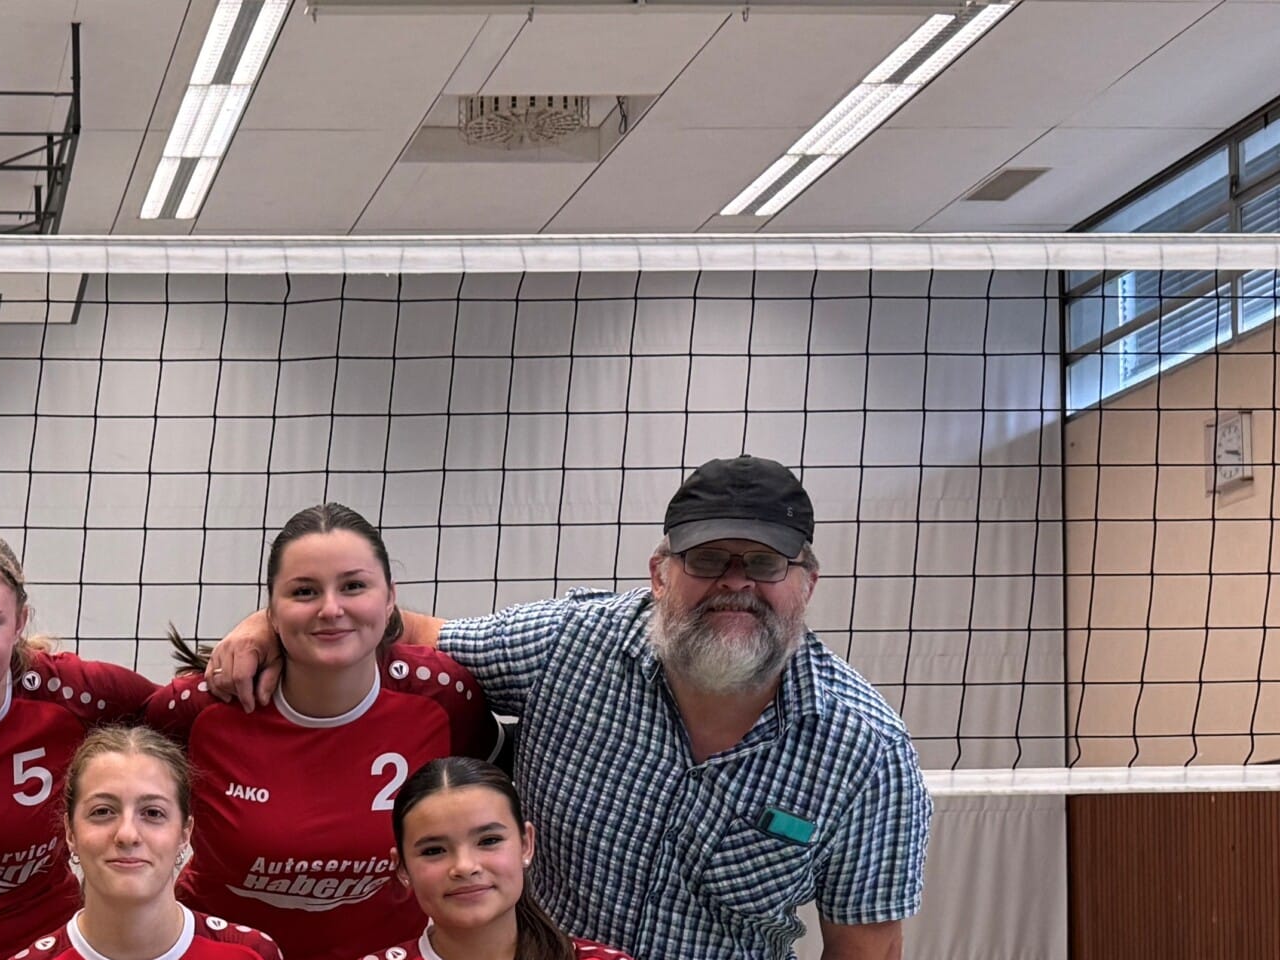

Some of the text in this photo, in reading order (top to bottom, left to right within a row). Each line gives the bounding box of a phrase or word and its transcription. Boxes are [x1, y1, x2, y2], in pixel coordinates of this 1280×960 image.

[12, 747, 53, 806] 5
[225, 782, 270, 803] JAKO
[371, 752, 409, 811] 2
